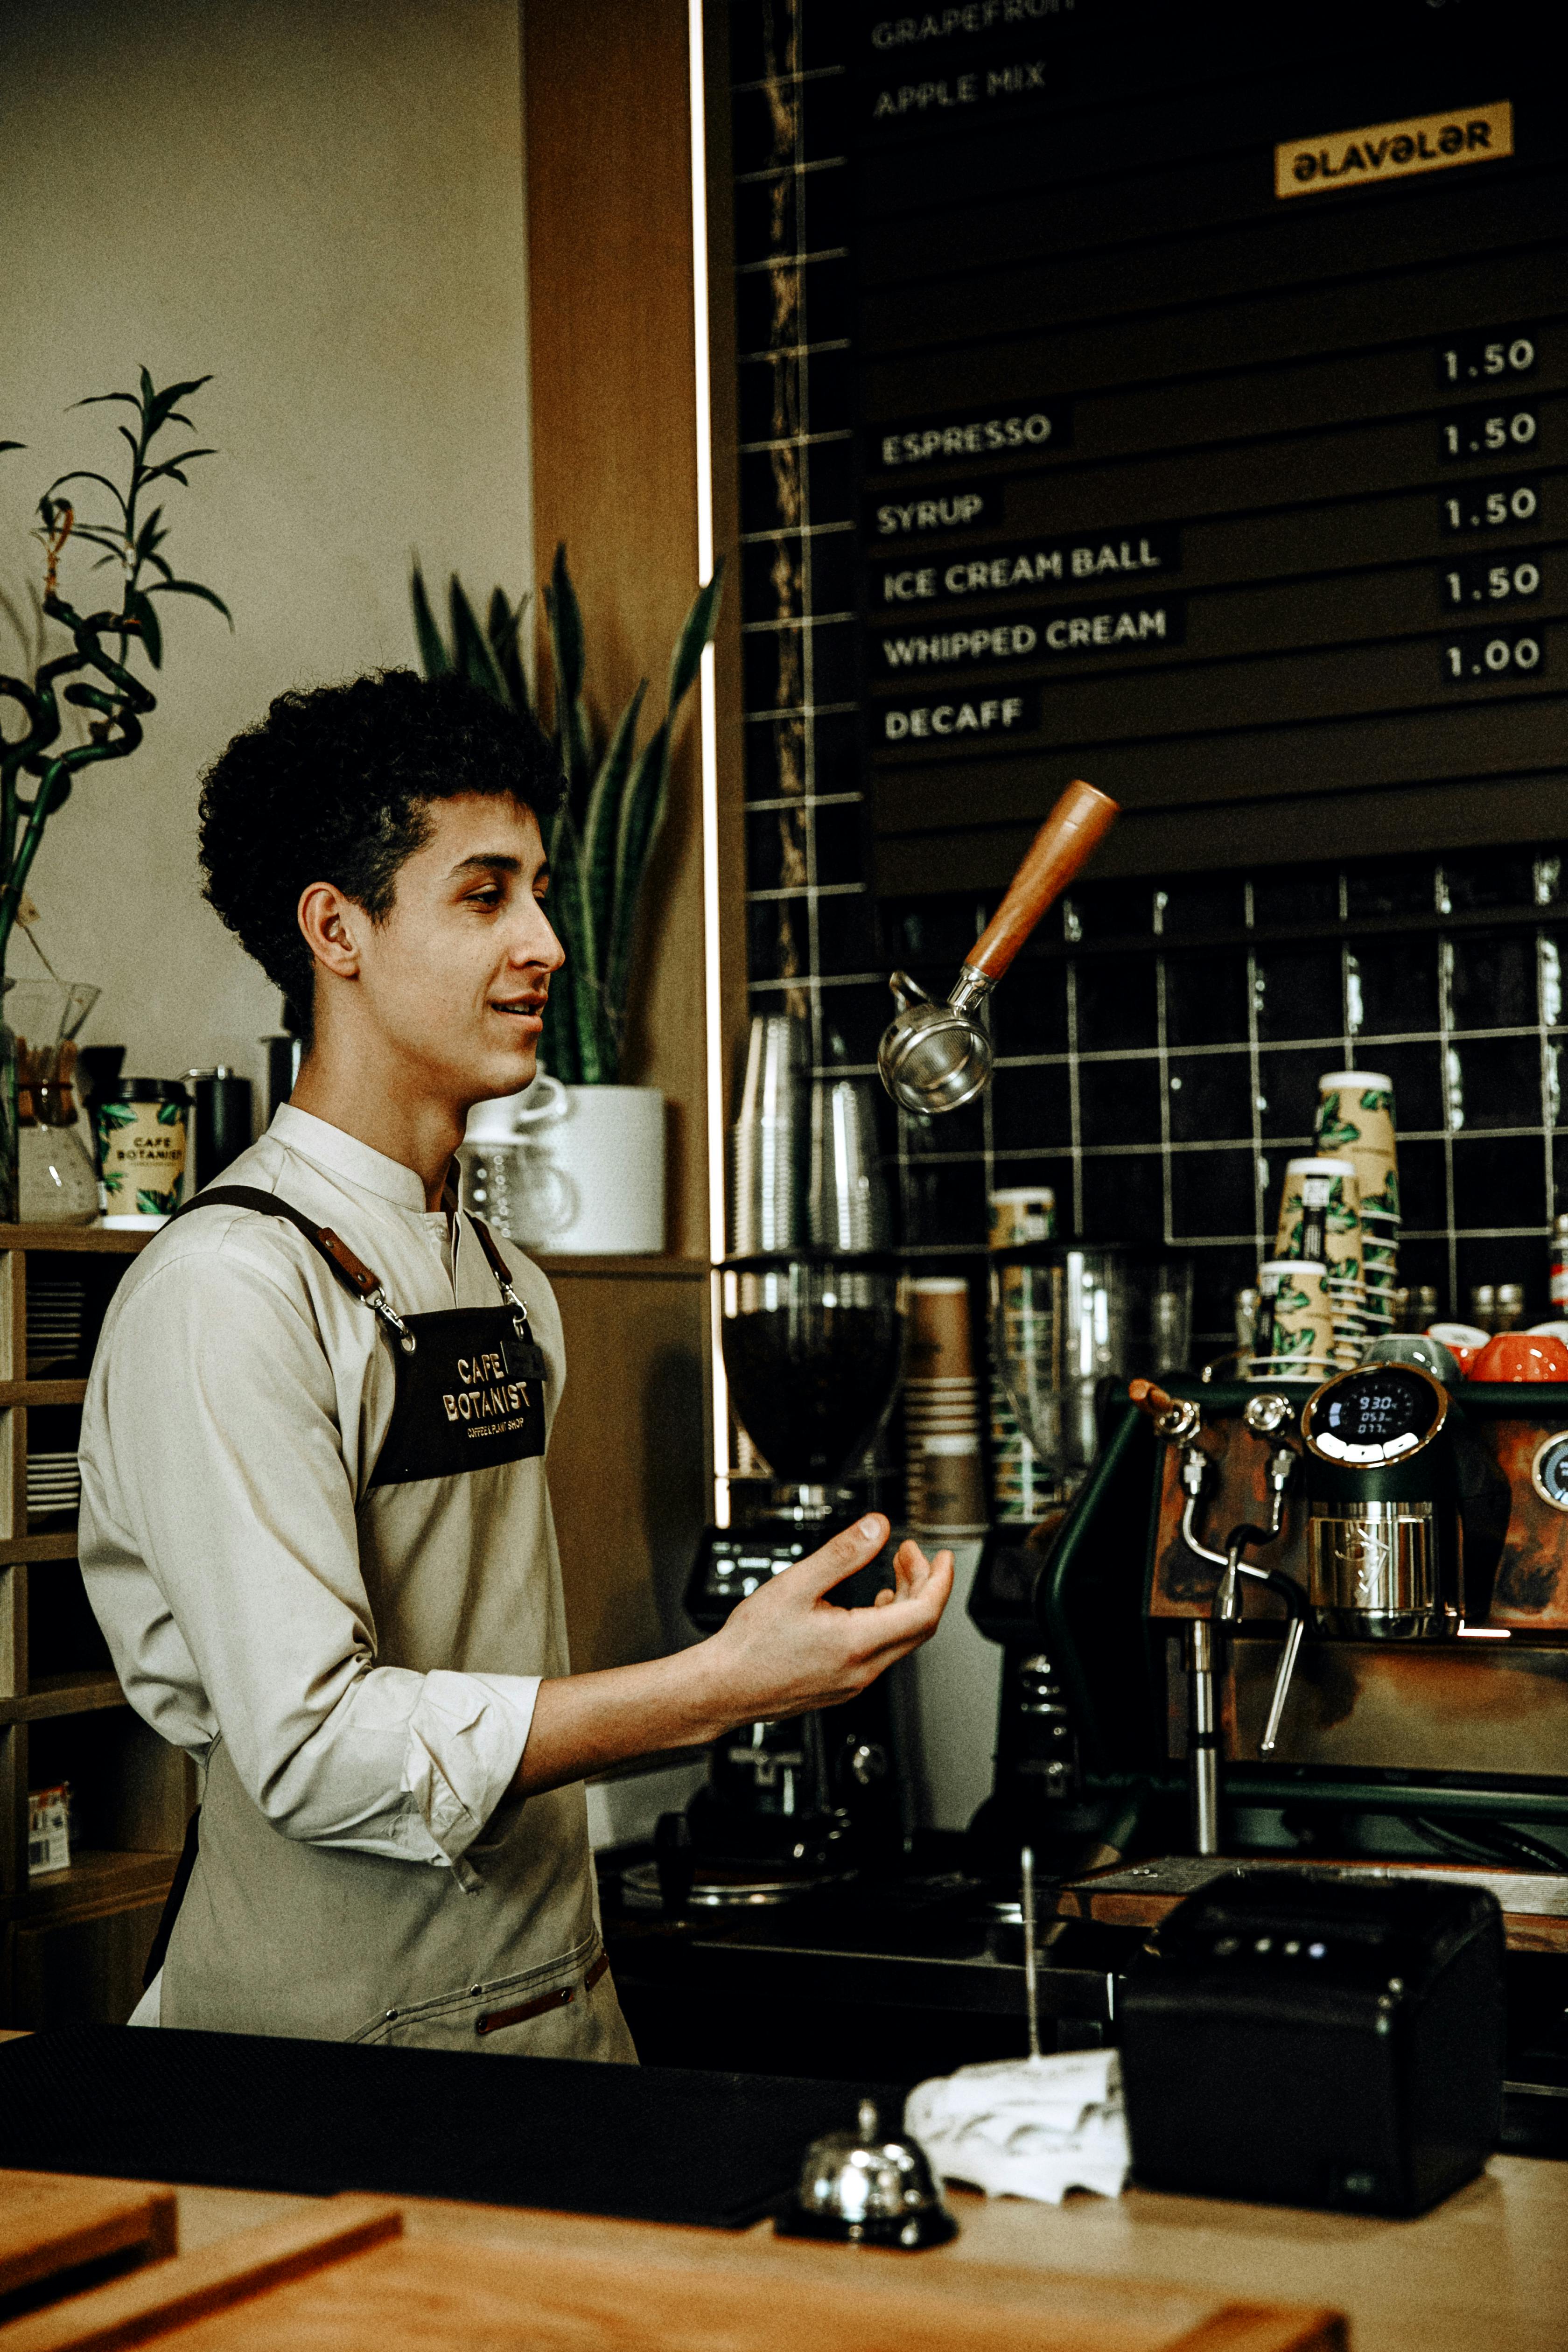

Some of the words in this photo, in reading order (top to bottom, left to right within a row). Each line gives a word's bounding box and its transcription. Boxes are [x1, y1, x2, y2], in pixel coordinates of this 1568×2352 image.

[872, 72, 979, 119] APPLE
[986, 59, 1047, 97] MIX
[1443, 338, 1534, 380] 1.50
[882, 413, 1052, 465] ESPRESSO
[1444, 413, 1536, 454] 1.50
[876, 493, 984, 534] SYRUP
[1445, 488, 1537, 528] 1.50
[883, 567, 936, 602] ICE
[944, 550, 1063, 594] CREAM
[1071, 538, 1160, 577] BALL
[1445, 563, 1540, 602] 1.50
[883, 624, 1036, 668] WHIPPED
[1045, 609, 1166, 650] CREAM
[1446, 637, 1540, 677] 1.00
[885, 697, 1023, 740] DECAFF
[134, 1137, 171, 1148] CAFE
[458, 1353, 504, 1384] CAFE
[443, 1381, 530, 1421] BOTANIST
[508, 1417, 524, 1430] SHOP
